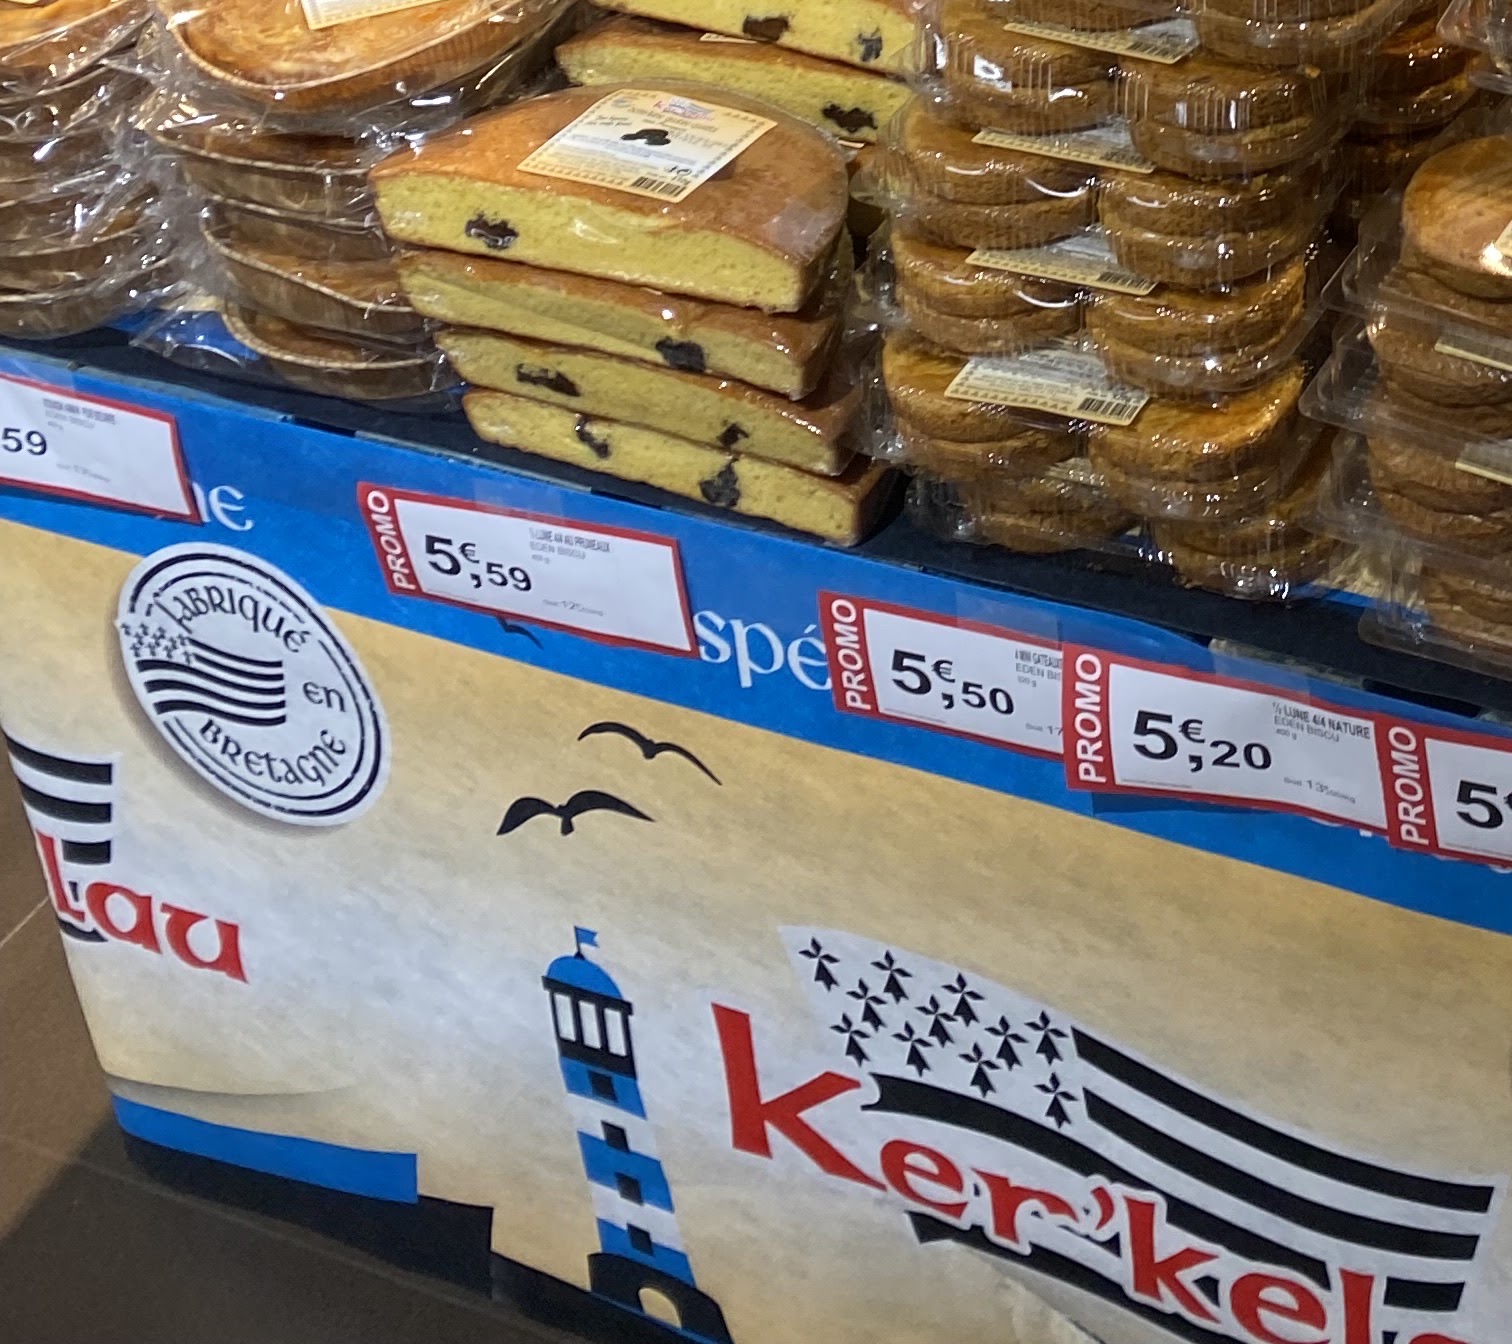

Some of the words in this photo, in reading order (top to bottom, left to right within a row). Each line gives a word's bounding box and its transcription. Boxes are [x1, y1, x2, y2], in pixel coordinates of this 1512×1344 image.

[366, 489, 417, 592] PROMO
[830, 598, 872, 711] PROMO
[1078, 653, 1107, 784] PROMO
[1273, 715, 1305, 732] EDEN
[1328, 718, 1371, 740] NATURE
[1387, 726, 1430, 846] PROMO
